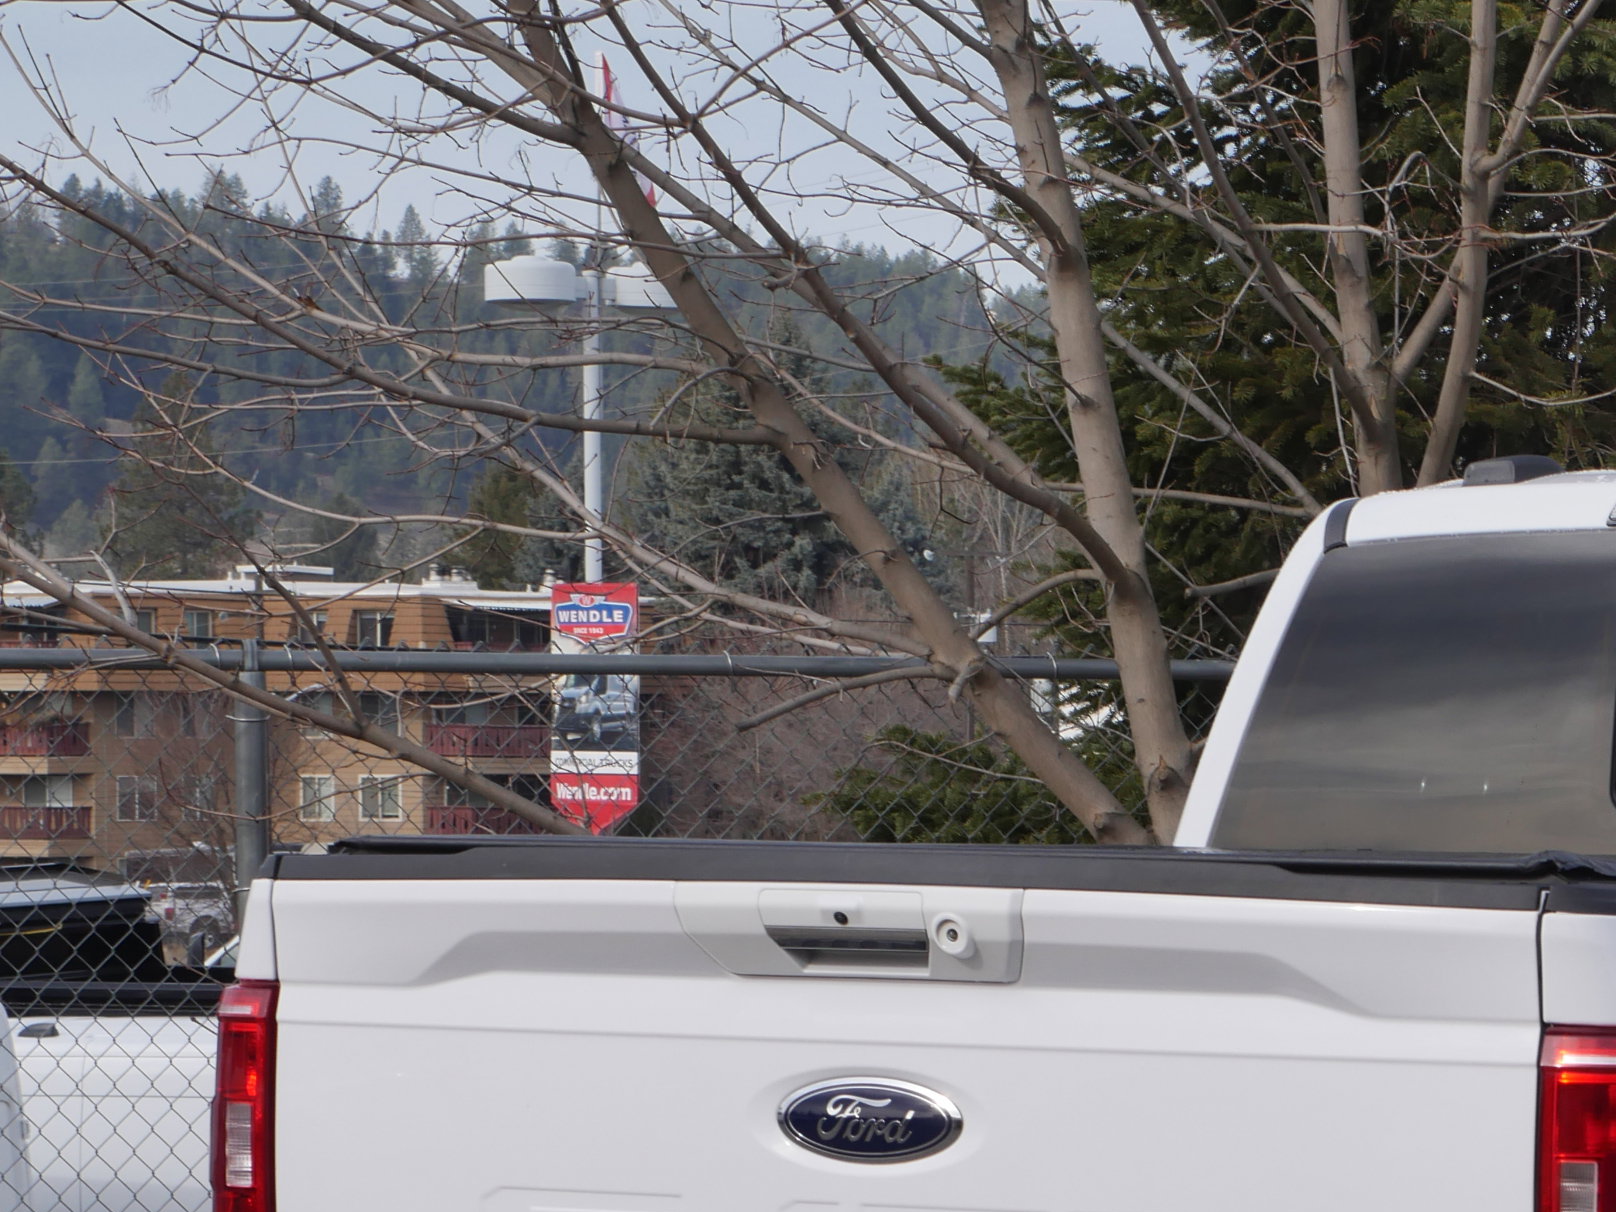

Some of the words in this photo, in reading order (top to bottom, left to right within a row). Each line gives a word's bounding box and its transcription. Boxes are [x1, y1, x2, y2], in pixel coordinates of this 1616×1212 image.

[558, 609, 624, 623] WENDLE
[555, 757, 597, 769] COMMCIAL
[556, 782, 632, 801] Wendle.com
[816, 1094, 916, 1144] Ford
